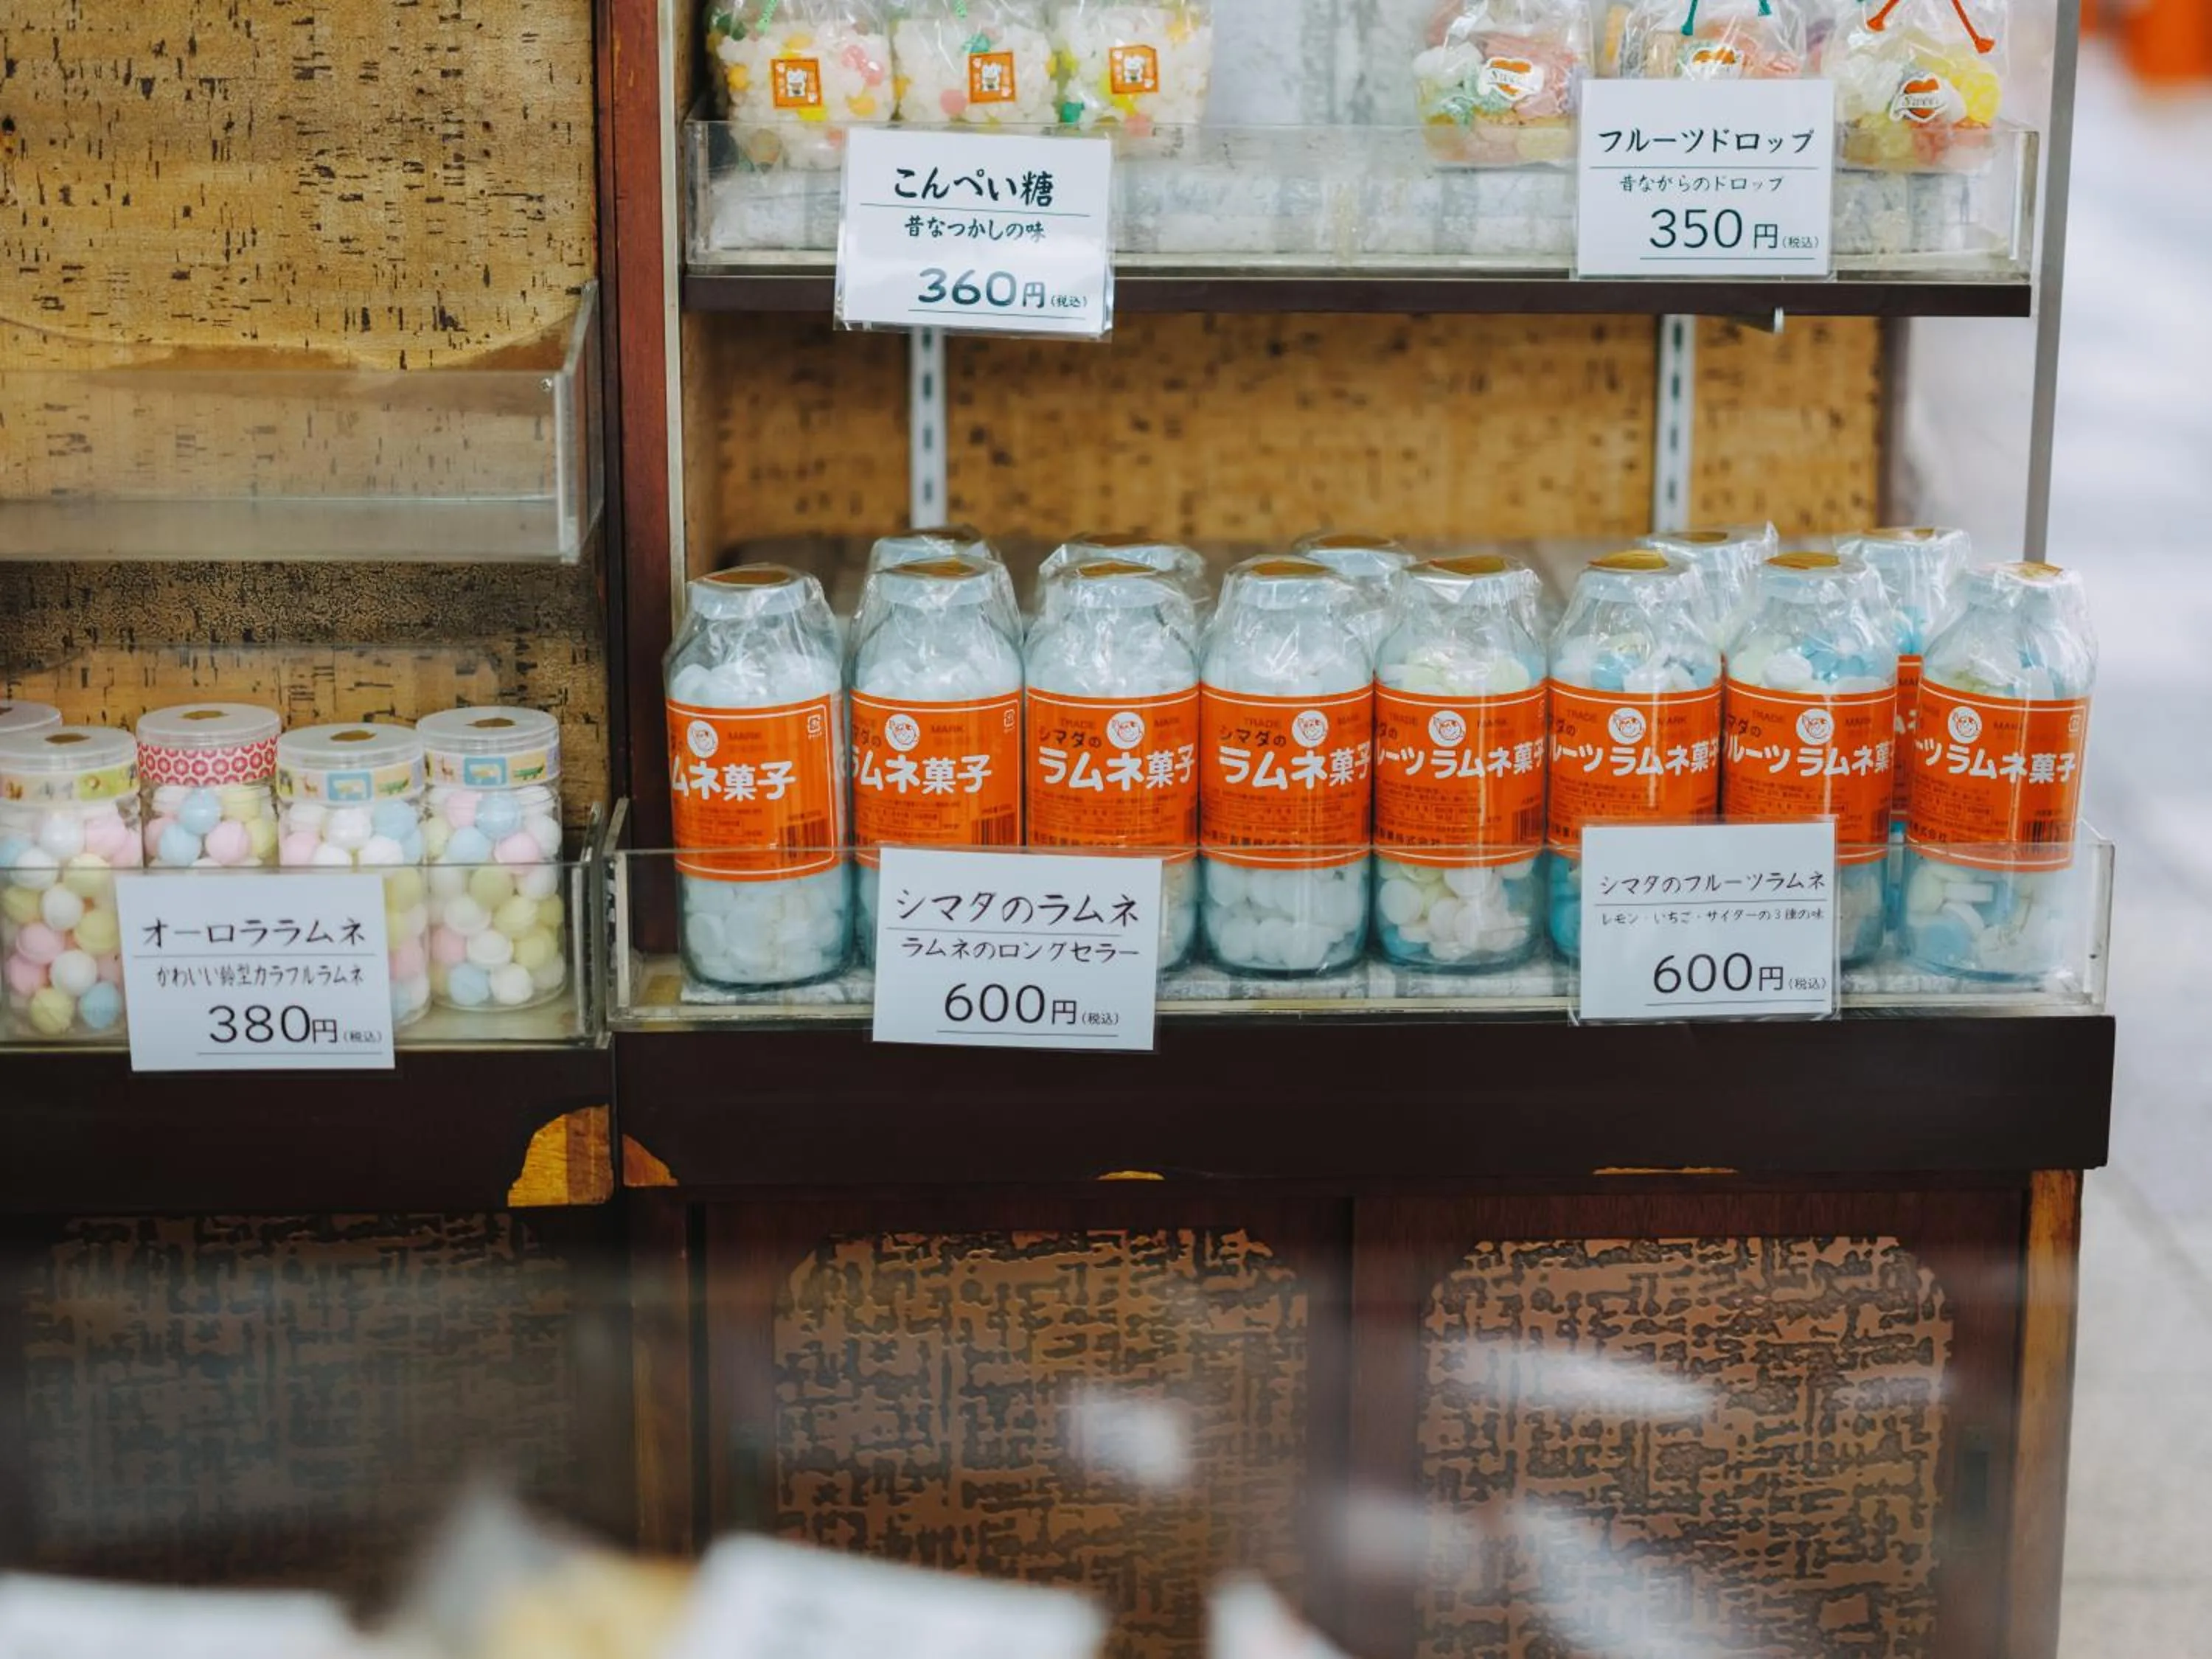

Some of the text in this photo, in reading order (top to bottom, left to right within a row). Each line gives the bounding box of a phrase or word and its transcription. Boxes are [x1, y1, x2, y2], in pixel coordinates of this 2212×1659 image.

[1598, 128, 1815, 153] フルーツドロップ
[894, 166, 1054, 207] こんぺい糖
[1619, 174, 1784, 192] 昔ながらのドロップ
[905, 215, 1046, 243] 昔なつかしの味
[1037, 742, 1195, 792] ラムネ菓子
[1219, 740, 1371, 790] ラムネ菓子
[1600, 871, 1825, 895] シマダのフルーツラムネ
[896, 889, 1139, 927] シマダのラムネ
[142, 917, 365, 948] オーロララムネ
[901, 936, 1140, 963] ラムネのロングセラー
